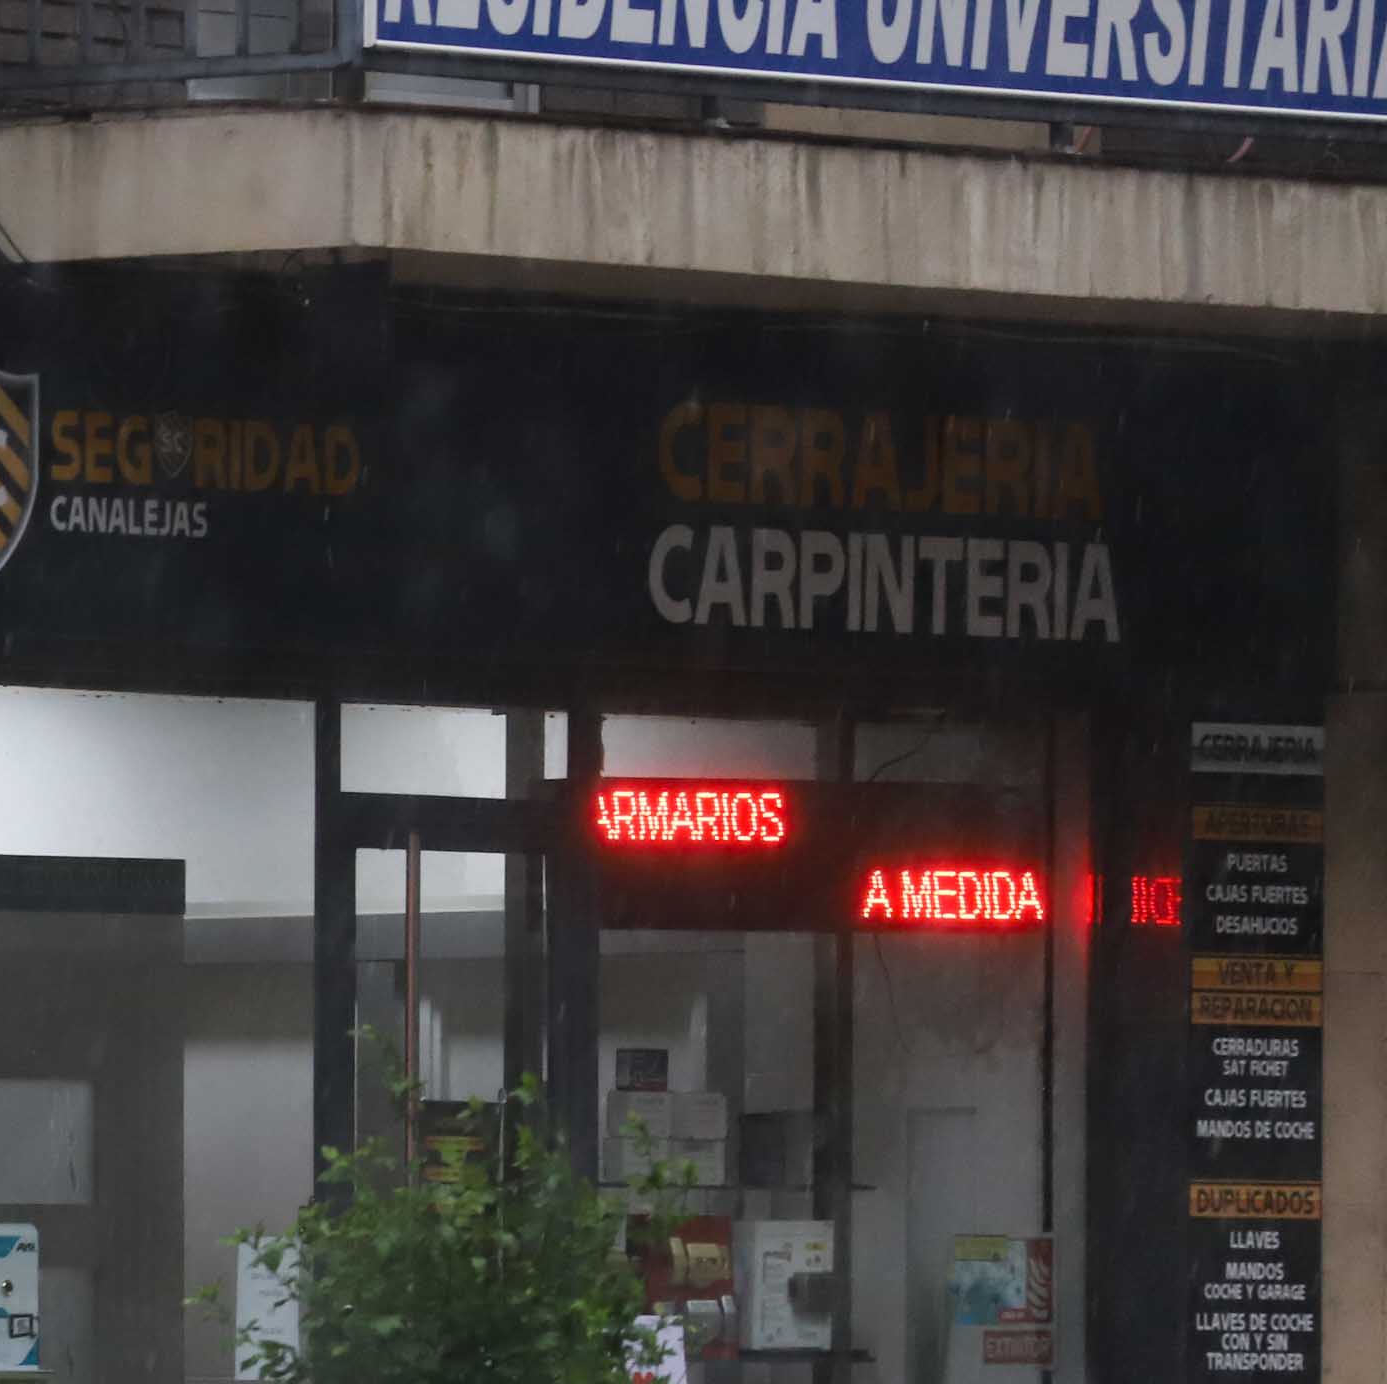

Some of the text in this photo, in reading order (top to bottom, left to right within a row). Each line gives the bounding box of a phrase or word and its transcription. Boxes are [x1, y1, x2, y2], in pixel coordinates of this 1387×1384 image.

[659, 399, 1104, 520] CERRAJERIA
[49, 496, 209, 538] CANALEJAS
[647, 522, 1122, 643] CARPINTERIA
[1227, 853, 1288, 872] PUERTAS
[863, 868, 1045, 921] A MEDIDA
[1205, 884, 1309, 905] CAJAS FUERTES
[1216, 915, 1298, 935] DESAHUCIOS
[1212, 1037, 1299, 1057] CERRADURAS
[1222, 1060, 1288, 1077] SAT FICHET
[1204, 1088, 1307, 1108] CAJAS FUERTES
[1196, 1120, 1315, 1140] MANDOS DE COCHE
[1195, 1188, 1314, 1214] DUPLICADOS
[1229, 1231, 1280, 1249] LLAVES
[1225, 1262, 1284, 1280] MANDOS
[1204, 1283, 1307, 1301] COCHE Y GARAGE
[1196, 1313, 1315, 1332] LLAVES DE COCHE
[1222, 1333, 1288, 1351] CON Y SIN
[1205, 1352, 1304, 1371] TRANSPONDER
